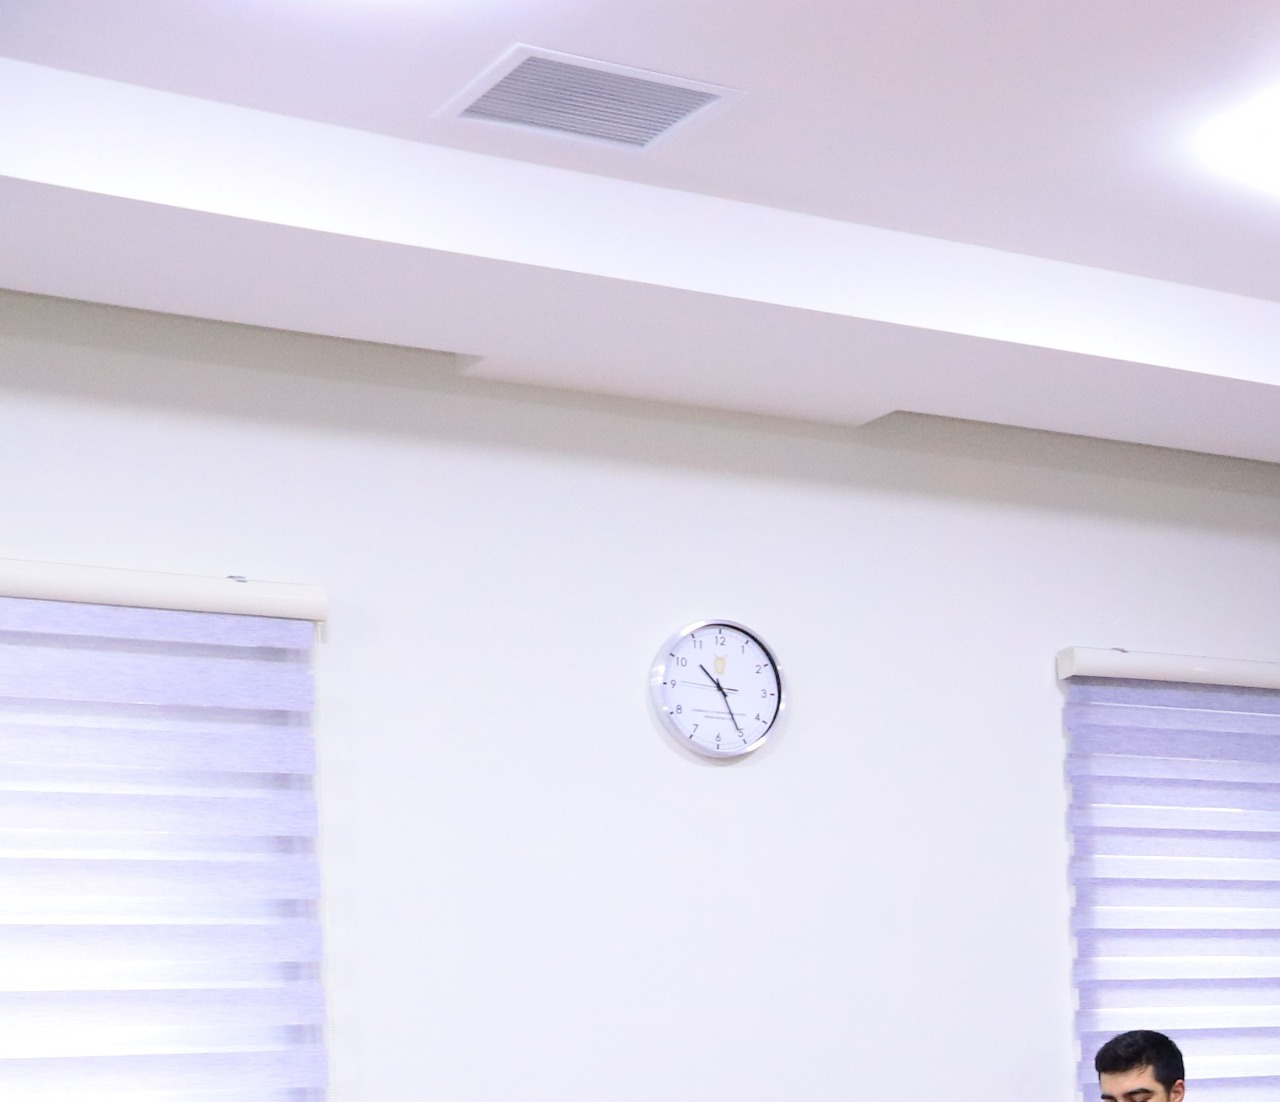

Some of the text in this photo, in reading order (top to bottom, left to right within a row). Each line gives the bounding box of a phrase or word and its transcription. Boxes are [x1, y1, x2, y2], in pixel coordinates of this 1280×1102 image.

[693, 640, 703, 650] 11
[714, 635, 726, 646] 12
[676, 656, 687, 667] 10
[755, 664, 762, 674] 2
[670, 680, 677, 689] 9
[761, 689, 767, 698] 3
[676, 704, 683, 714] 8
[755, 713, 760, 721] 4
[692, 723, 699, 733] 7
[738, 728, 744, 738] 5
[715, 733, 721, 742] 6
